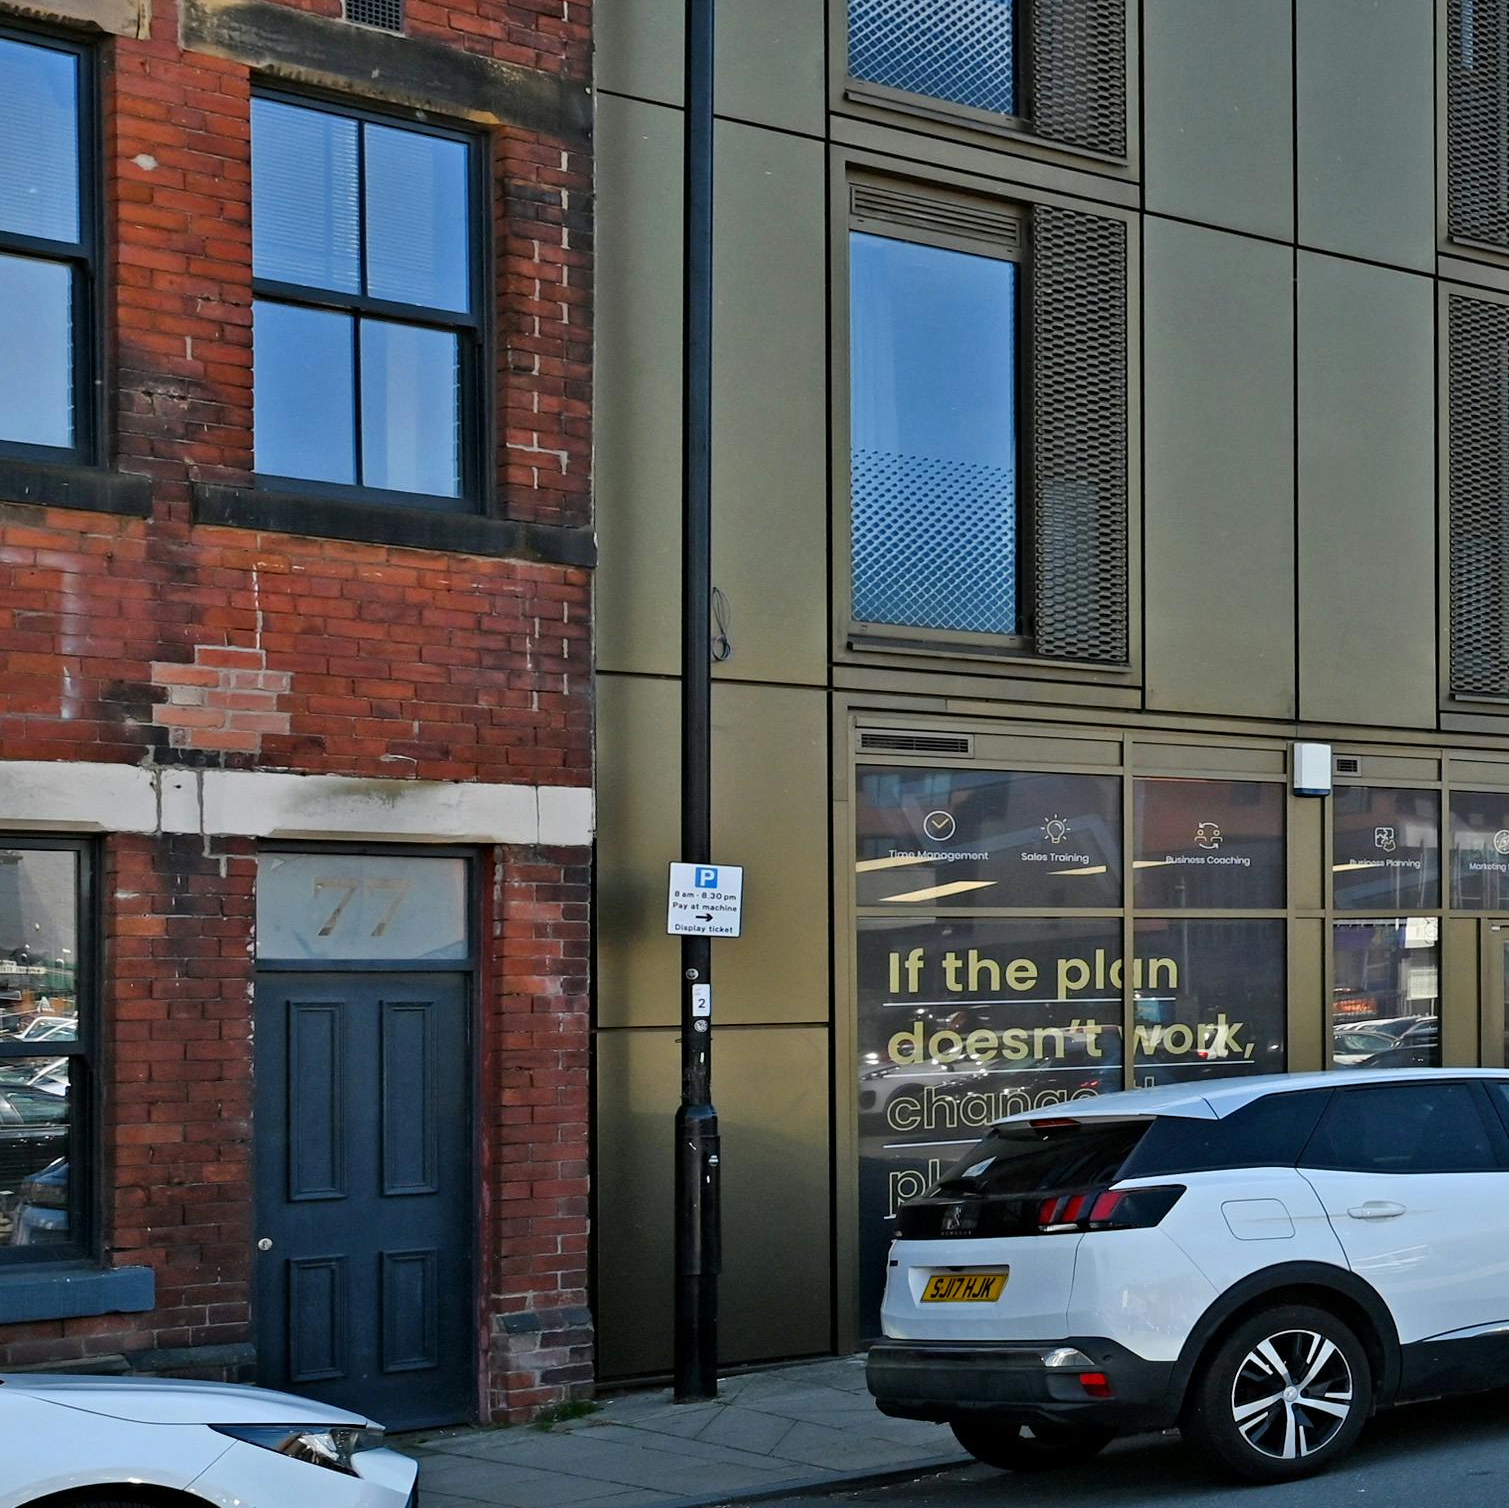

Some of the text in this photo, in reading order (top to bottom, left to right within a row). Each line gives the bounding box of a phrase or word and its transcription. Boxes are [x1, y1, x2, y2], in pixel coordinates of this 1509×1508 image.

[888, 848, 989, 863] Time Management
[1021, 851, 1090, 865] Sales Training
[1165, 854, 1251, 867] Business Coaching
[1349, 858, 1421, 869] Business Planning
[1469, 861, 1507, 873] Marketing
[700, 869, 715, 886] P
[723, 894, 737, 903] pm
[313, 876, 417, 937] 77
[672, 901, 688, 911] Pay
[702, 903, 738, 913] machine
[675, 923, 733, 934] Display ticket
[889, 947, 1178, 1001] If the plan
[697, 998, 706, 1009] 2
[887, 1013, 1255, 1065] doesn't work,
[887, 1086, 1099, 1132] chan
[930, 1277, 996, 1299] SJ17 HJK
